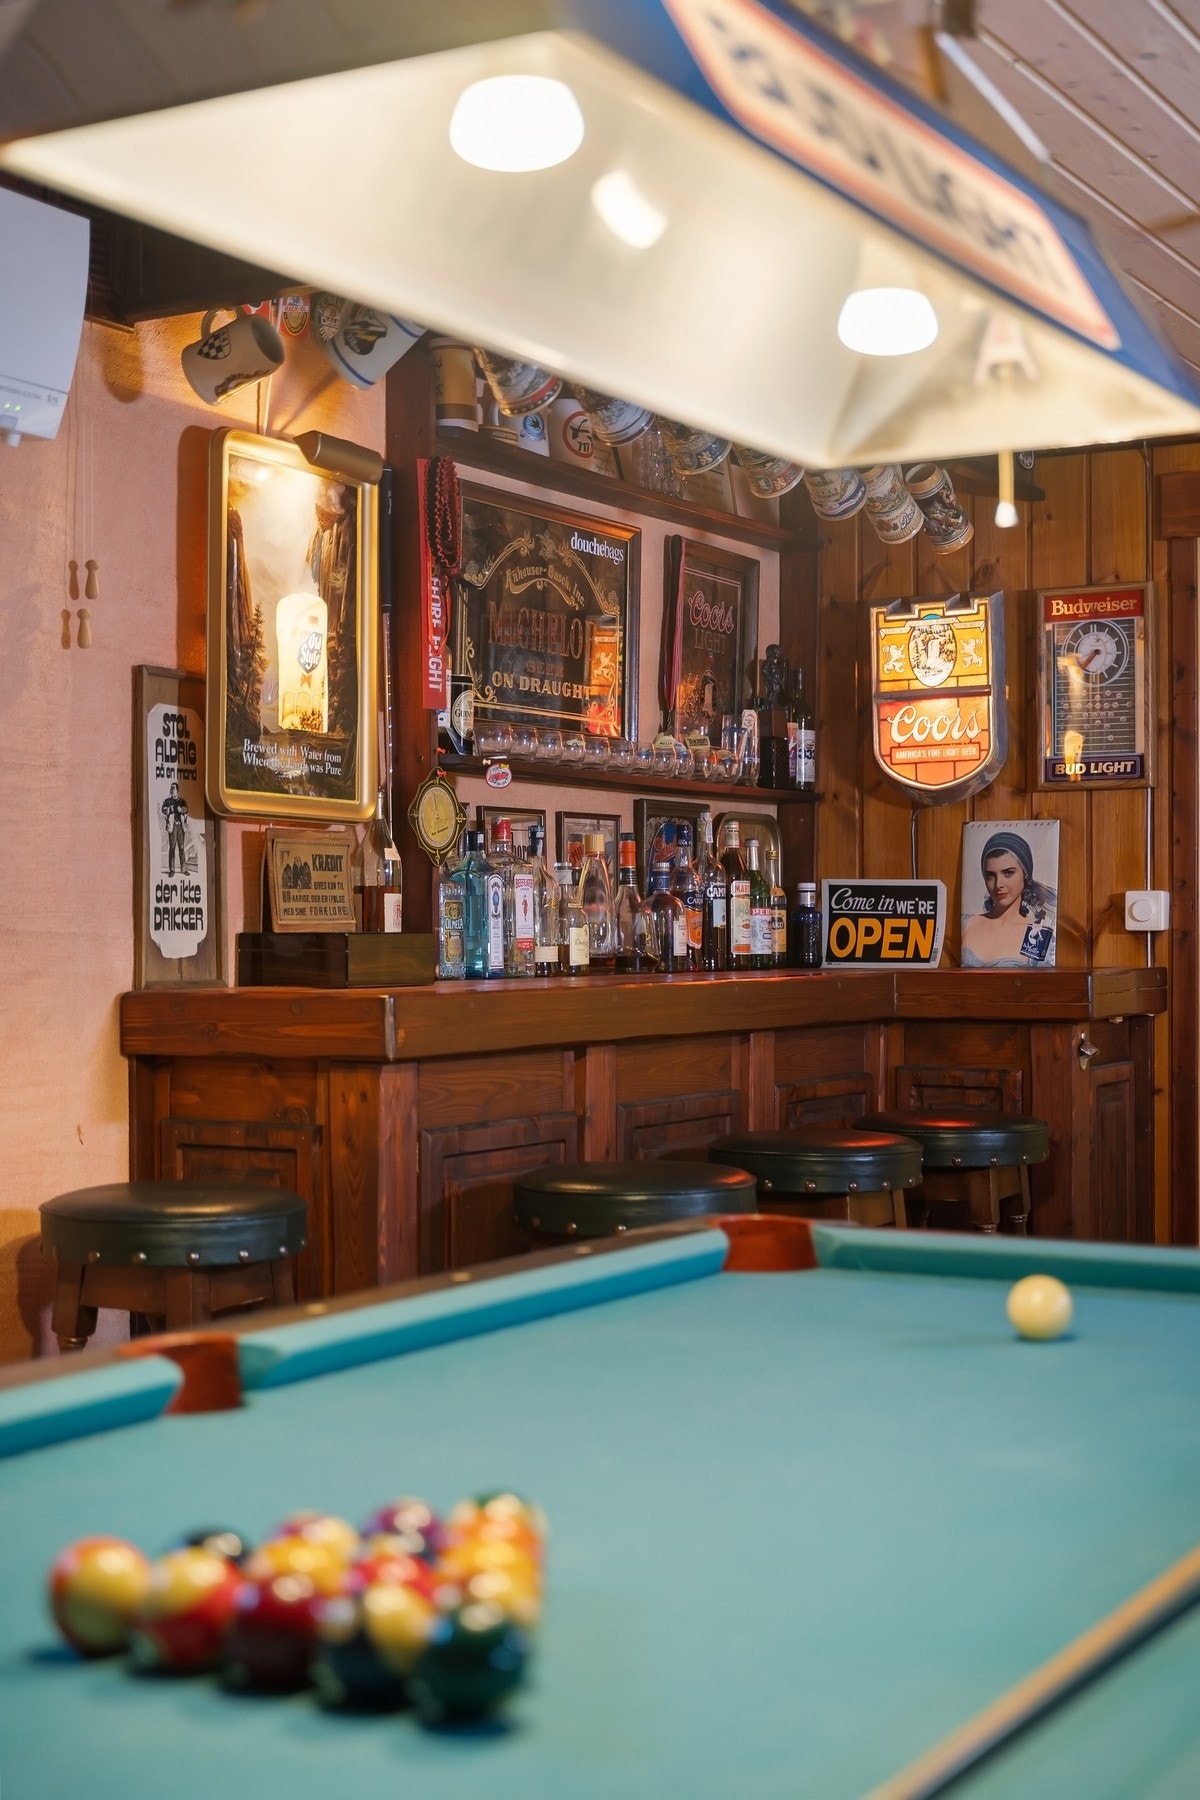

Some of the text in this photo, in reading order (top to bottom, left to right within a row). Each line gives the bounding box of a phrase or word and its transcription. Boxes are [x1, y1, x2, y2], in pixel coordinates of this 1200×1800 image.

[577, 441, 590, 452] 717
[571, 532, 624, 565] douchebags
[689, 591, 734, 634] Coors
[1051, 597, 1137, 616] Budweiser
[695, 628, 727, 655] LIGHT
[492, 671, 592, 700] ON DRAUGHT
[163, 712, 191, 739] STOL
[887, 704, 982, 743] Coors
[155, 738, 197, 766] ALDRIG
[244, 738, 342, 763] Brewed with Water from
[895, 747, 977, 760] AMERICA'S FINE LIGHT BEER
[155, 763, 197, 781] på en mand
[243, 752, 269, 767] When
[310, 764, 323, 773] was
[325, 762, 342, 776] Pure
[1055, 761, 1135, 775] BUD LIGHT
[155, 879, 202, 904] der ikke
[831, 887, 936, 915] Come in WE'RE
[154, 906, 204, 931] DRIKKER
[829, 917, 935, 959] OPEN
